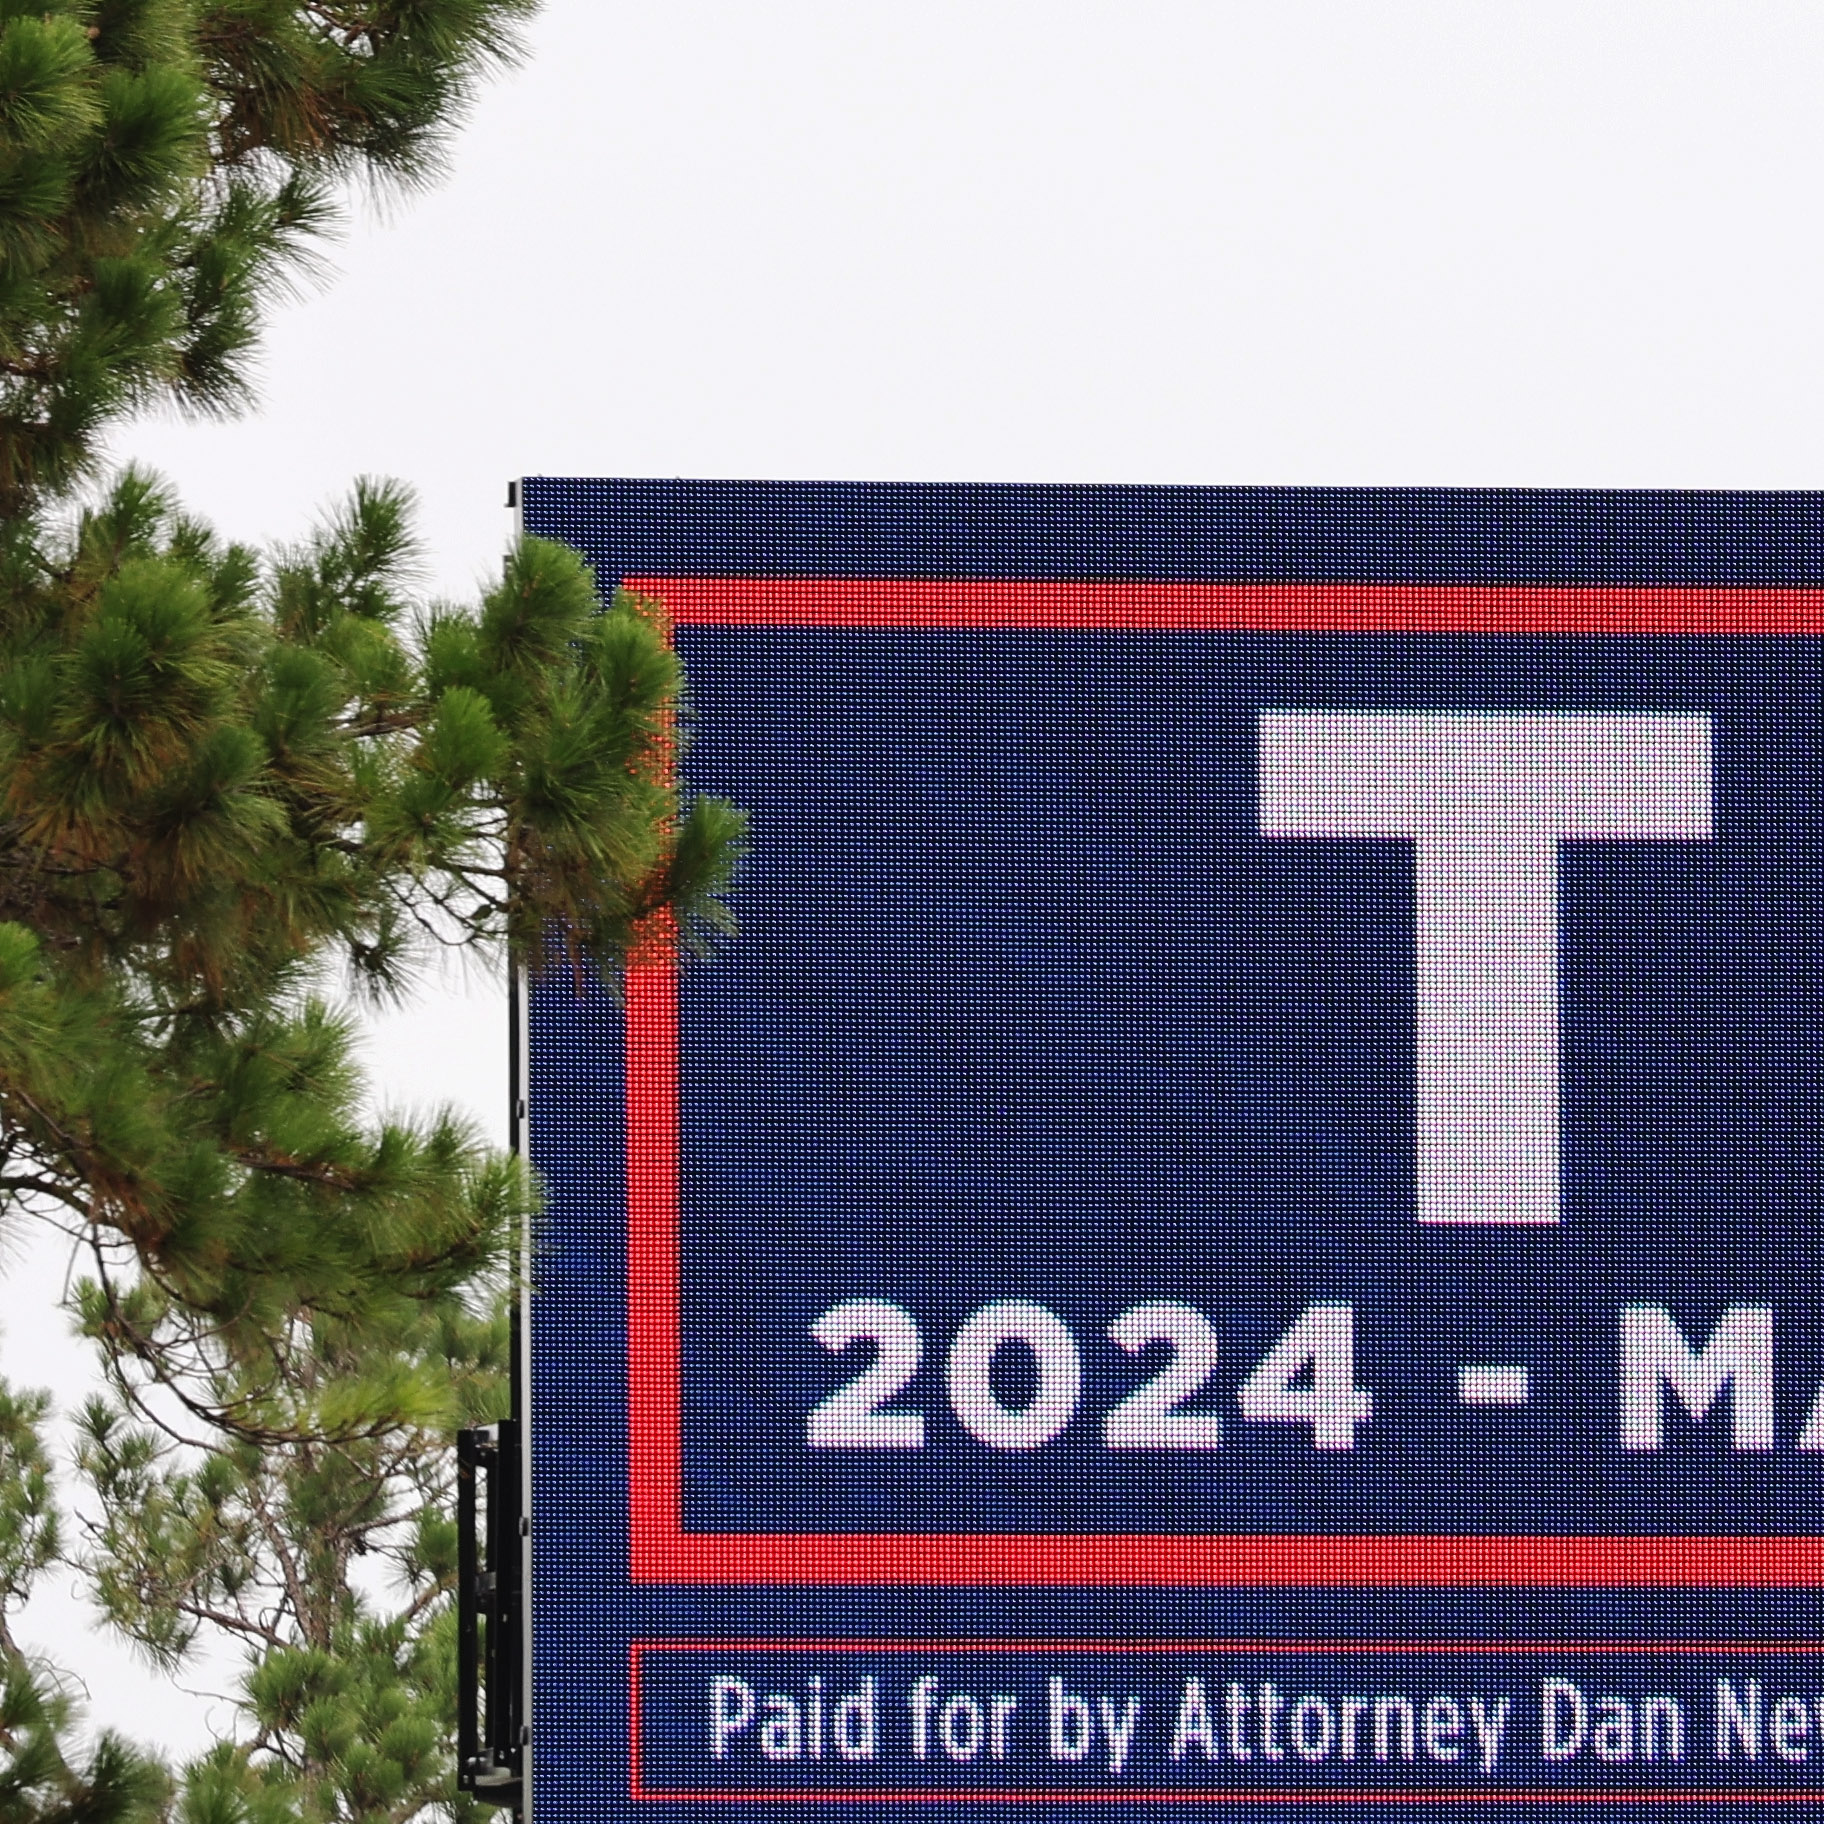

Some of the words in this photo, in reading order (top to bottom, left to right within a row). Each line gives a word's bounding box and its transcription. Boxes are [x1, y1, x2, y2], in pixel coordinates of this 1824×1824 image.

[806, 1298, 1371, 1450] 2024
[709, 1675, 877, 1760] Paid
[908, 1676, 1018, 1760] for
[1048, 1676, 1140, 1772] by
[1171, 1678, 1509, 1772] Attorney
[1542, 1677, 1684, 1761] Dan
